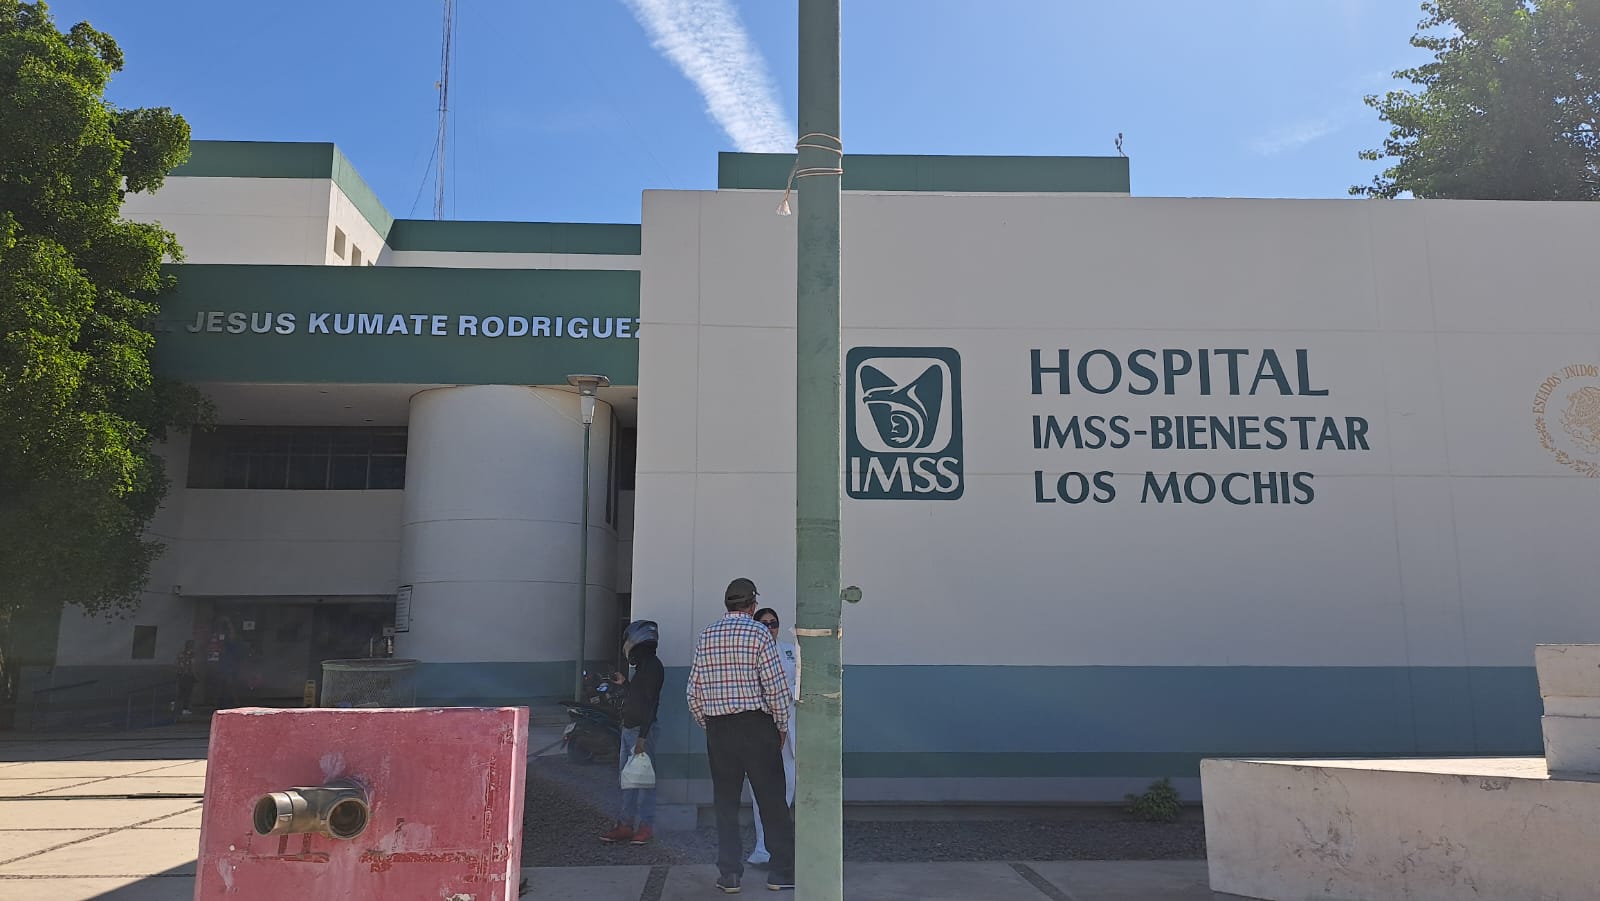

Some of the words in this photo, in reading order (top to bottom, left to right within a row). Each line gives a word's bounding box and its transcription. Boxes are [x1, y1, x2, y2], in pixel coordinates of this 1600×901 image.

[187, 311, 297, 336] JESUS
[308, 312, 448, 336] KUMATE
[1030, 348, 1330, 397] HOSPITAL
[1533, 376, 1561, 413] ESTADOS
[1033, 415, 1371, 451] IMSS-BIENESTAR
[852, 457, 961, 493] IMSS
[1035, 470, 1116, 504] LOS
[1141, 472, 1315, 505] MOCHIS
